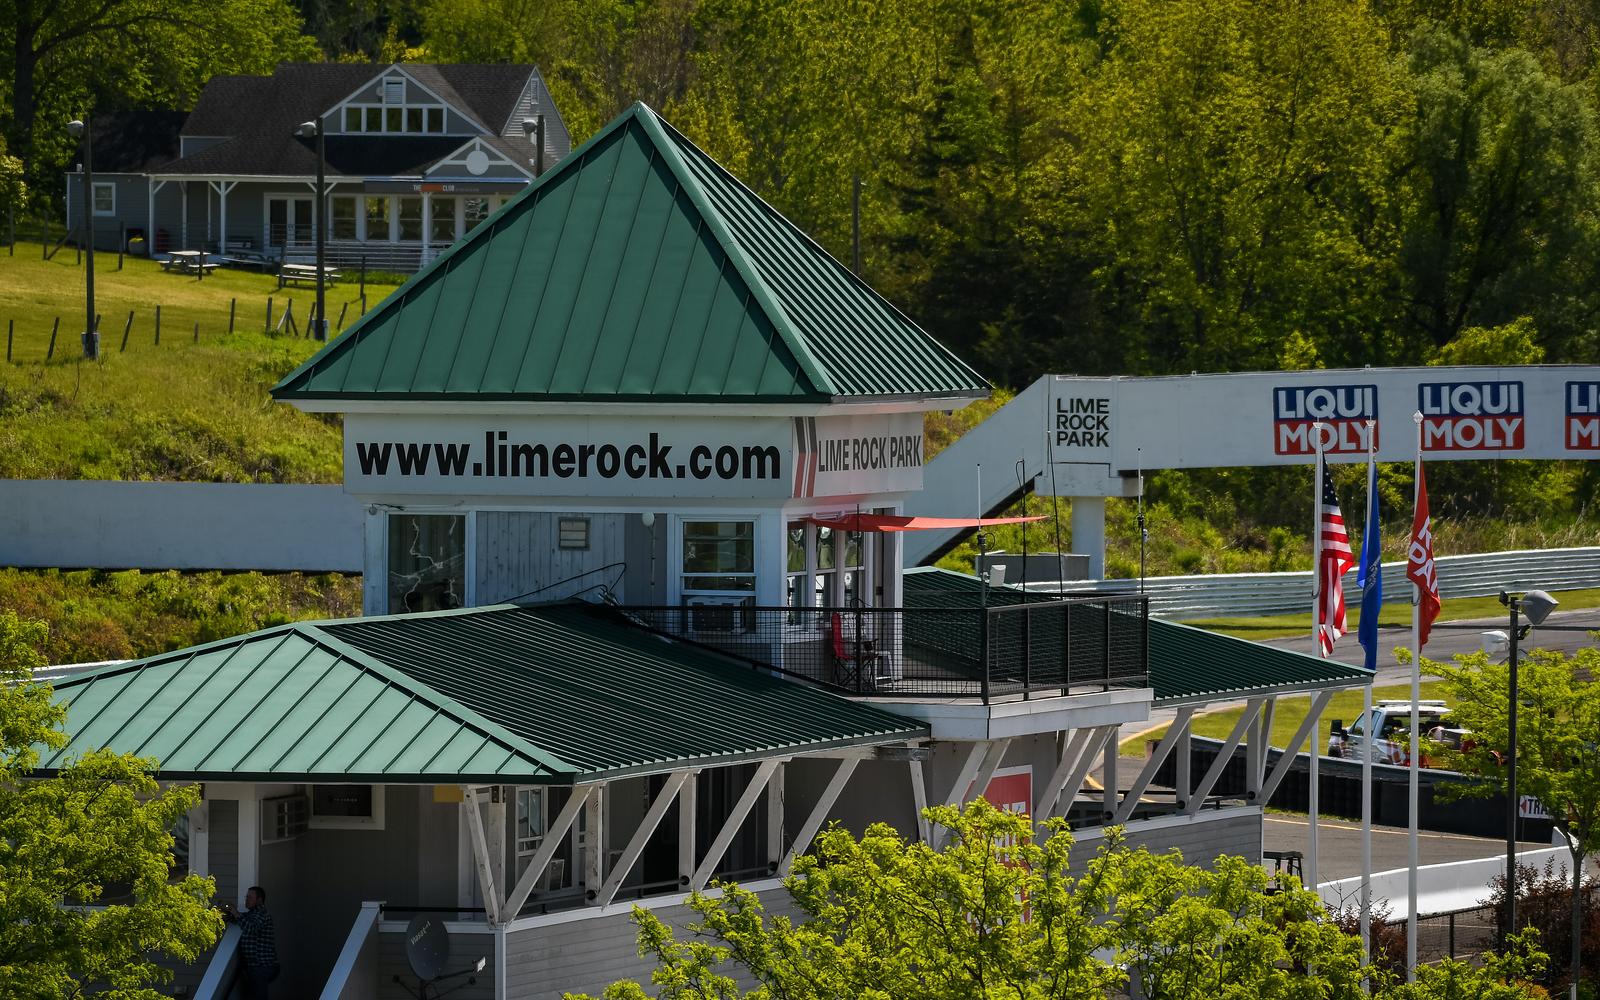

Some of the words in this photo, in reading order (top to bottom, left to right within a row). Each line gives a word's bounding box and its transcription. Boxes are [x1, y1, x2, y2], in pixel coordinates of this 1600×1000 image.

[1056, 398, 1110, 414] LIME
[1278, 387, 1373, 419] LIQUI
[1423, 384, 1519, 416] LIQUI
[1570, 384, 1600, 413] LI
[1056, 414, 1110, 431] ROCK
[1279, 421, 1376, 452] MOLY
[1424, 418, 1522, 448] MOLY
[818, 438, 850, 473] LIME
[852, 436, 887, 471] ROCK
[890, 434, 921, 469] PARK
[1056, 430, 1110, 448] PARK
[356, 431, 781, 479] www.limerock.com
